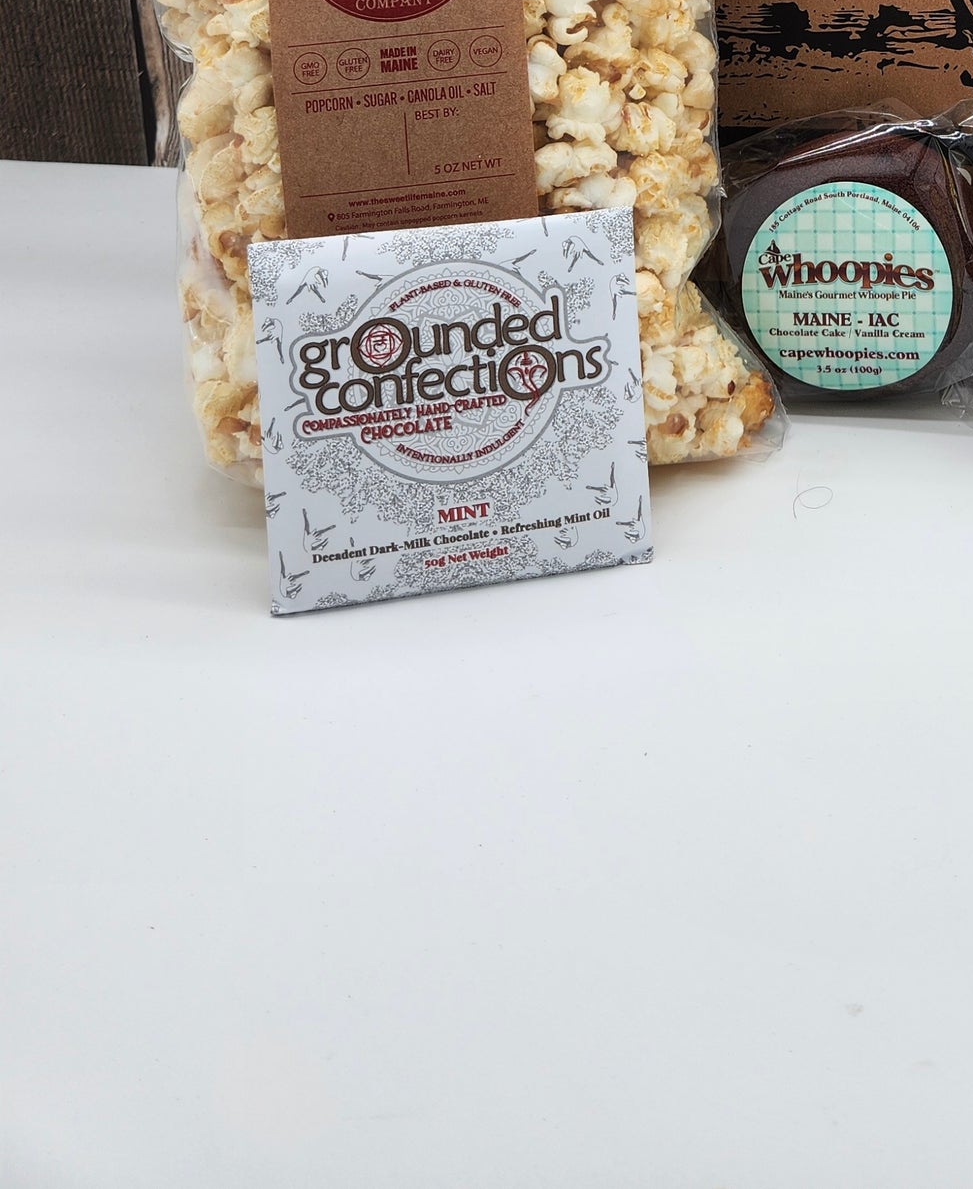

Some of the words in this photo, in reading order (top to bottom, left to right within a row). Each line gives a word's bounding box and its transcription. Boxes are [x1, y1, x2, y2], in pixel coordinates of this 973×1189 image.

[380, 47, 406, 58] MADE
[406, 46, 417, 56] IN
[433, 48, 455, 57] DAIRY
[473, 47, 498, 55] VEGAN
[301, 61, 320, 69] GMO
[339, 56, 368, 66] GLUTEN
[380, 59, 419, 73] MAINE
[436, 56, 453, 64] FREE
[302, 69, 320, 77] FREE
[305, 96, 353, 114] POPCORN
[364, 92, 398, 108] SUGAR
[407, 87, 447, 103] CANOLA
[449, 85, 464, 100] OIL
[473, 82, 497, 97] SALT
[415, 109, 440, 120] BEST
[443, 107, 459, 118] BY:
[435, 165, 440, 174] 5
[443, 162, 460, 173] OZ
[462, 160, 483, 171] NET
[485, 158, 502, 169] WT
[348, 189, 466, 208] www.thesweetlifemaine.com
[351, 209, 393, 219] Farmington
[394, 206, 410, 214] Falls
[411, 204, 431, 213] Road,
[433, 200, 476, 211] Farmington,
[768, 220, 779, 233] 185
[779, 201, 803, 223] Cottage
[804, 194, 823, 207] Road
[823, 191, 845, 199] South
[847, 191, 880, 204] Portland,
[881, 199, 901, 215] Maine
[902, 212, 921, 232] 04106
[758, 253, 792, 266] Cape
[389, 280, 451, 311] PLANT-BASED
[453, 279, 462, 287] &
[463, 279, 501, 294] GLUTEN
[501, 292, 522, 308] FREE
[778, 290, 813, 299] Maine's
[815, 290, 856, 299] Gourmet
[857, 291, 900, 301] Whoopie
[901, 292, 916, 300] Pie
[793, 313, 852, 326] MAINE
[868, 313, 900, 327] IAC
[769, 328, 819, 337] Chocolate
[822, 329, 846, 337] Cake
[855, 329, 889, 338] Vanilla
[892, 330, 925, 338] Cream
[779, 347, 919, 362] capewhoopies.com
[816, 365, 831, 373] 3.5
[850, 366, 882, 375] (100g)
[302, 407, 412, 434] COMPASSIONATELY
[415, 394, 507, 419] HAND-CRAFTED
[361, 416, 452, 444] CHOCOLATE
[396, 443, 474, 464] INTENTIONALLY
[475, 419, 525, 458] INDULGENT
[437, 502, 490, 523] MINT
[312, 547, 367, 564] Decadent
[370, 538, 431, 555] Dark-Milk
[433, 529, 490, 546] Chocolate
[501, 517, 562, 536] Refreshing
[564, 512, 591, 525] Mint
[593, 508, 610, 520] Oil
[424, 558, 446, 569] 50g
[448, 553, 468, 563] Net
[469, 545, 509, 561] Weight
